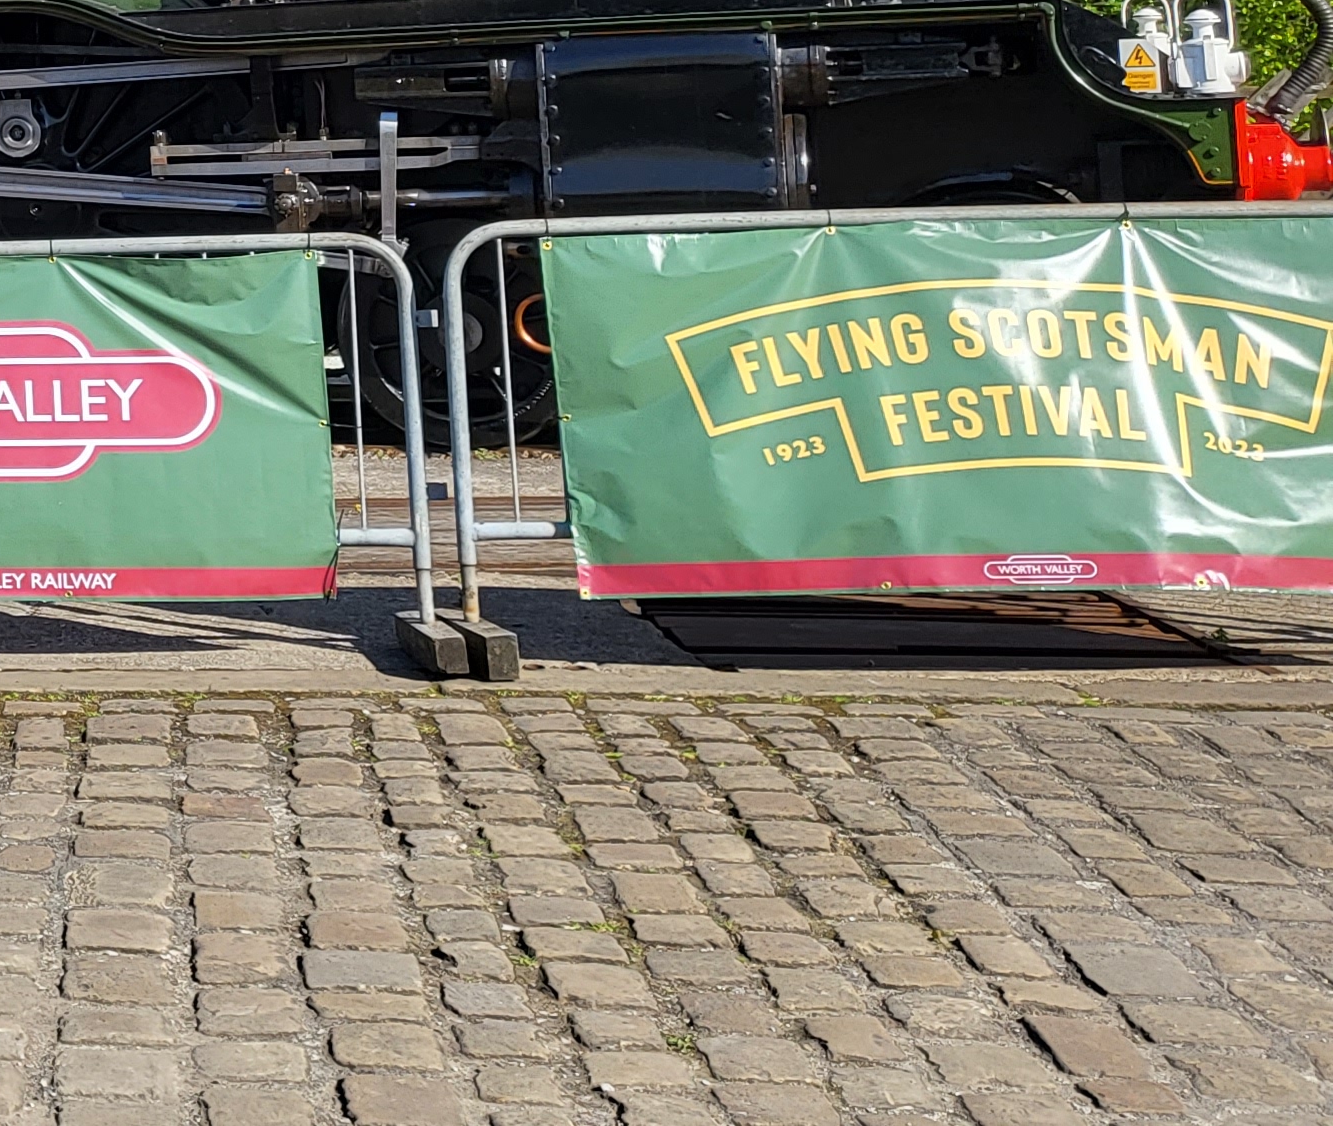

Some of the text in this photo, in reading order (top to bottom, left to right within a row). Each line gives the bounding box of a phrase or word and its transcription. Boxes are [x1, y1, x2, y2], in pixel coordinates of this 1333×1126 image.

[730, 308, 1273, 394] FLYING SCOTSMAN
[879, 384, 1147, 446] FESTIVAL
[762, 436, 826, 466] 1923
[1203, 431, 1264, 462] 2023
[31, 573, 117, 589] RAILWAY
[997, 564, 1083, 574] WORTH VALLEY
